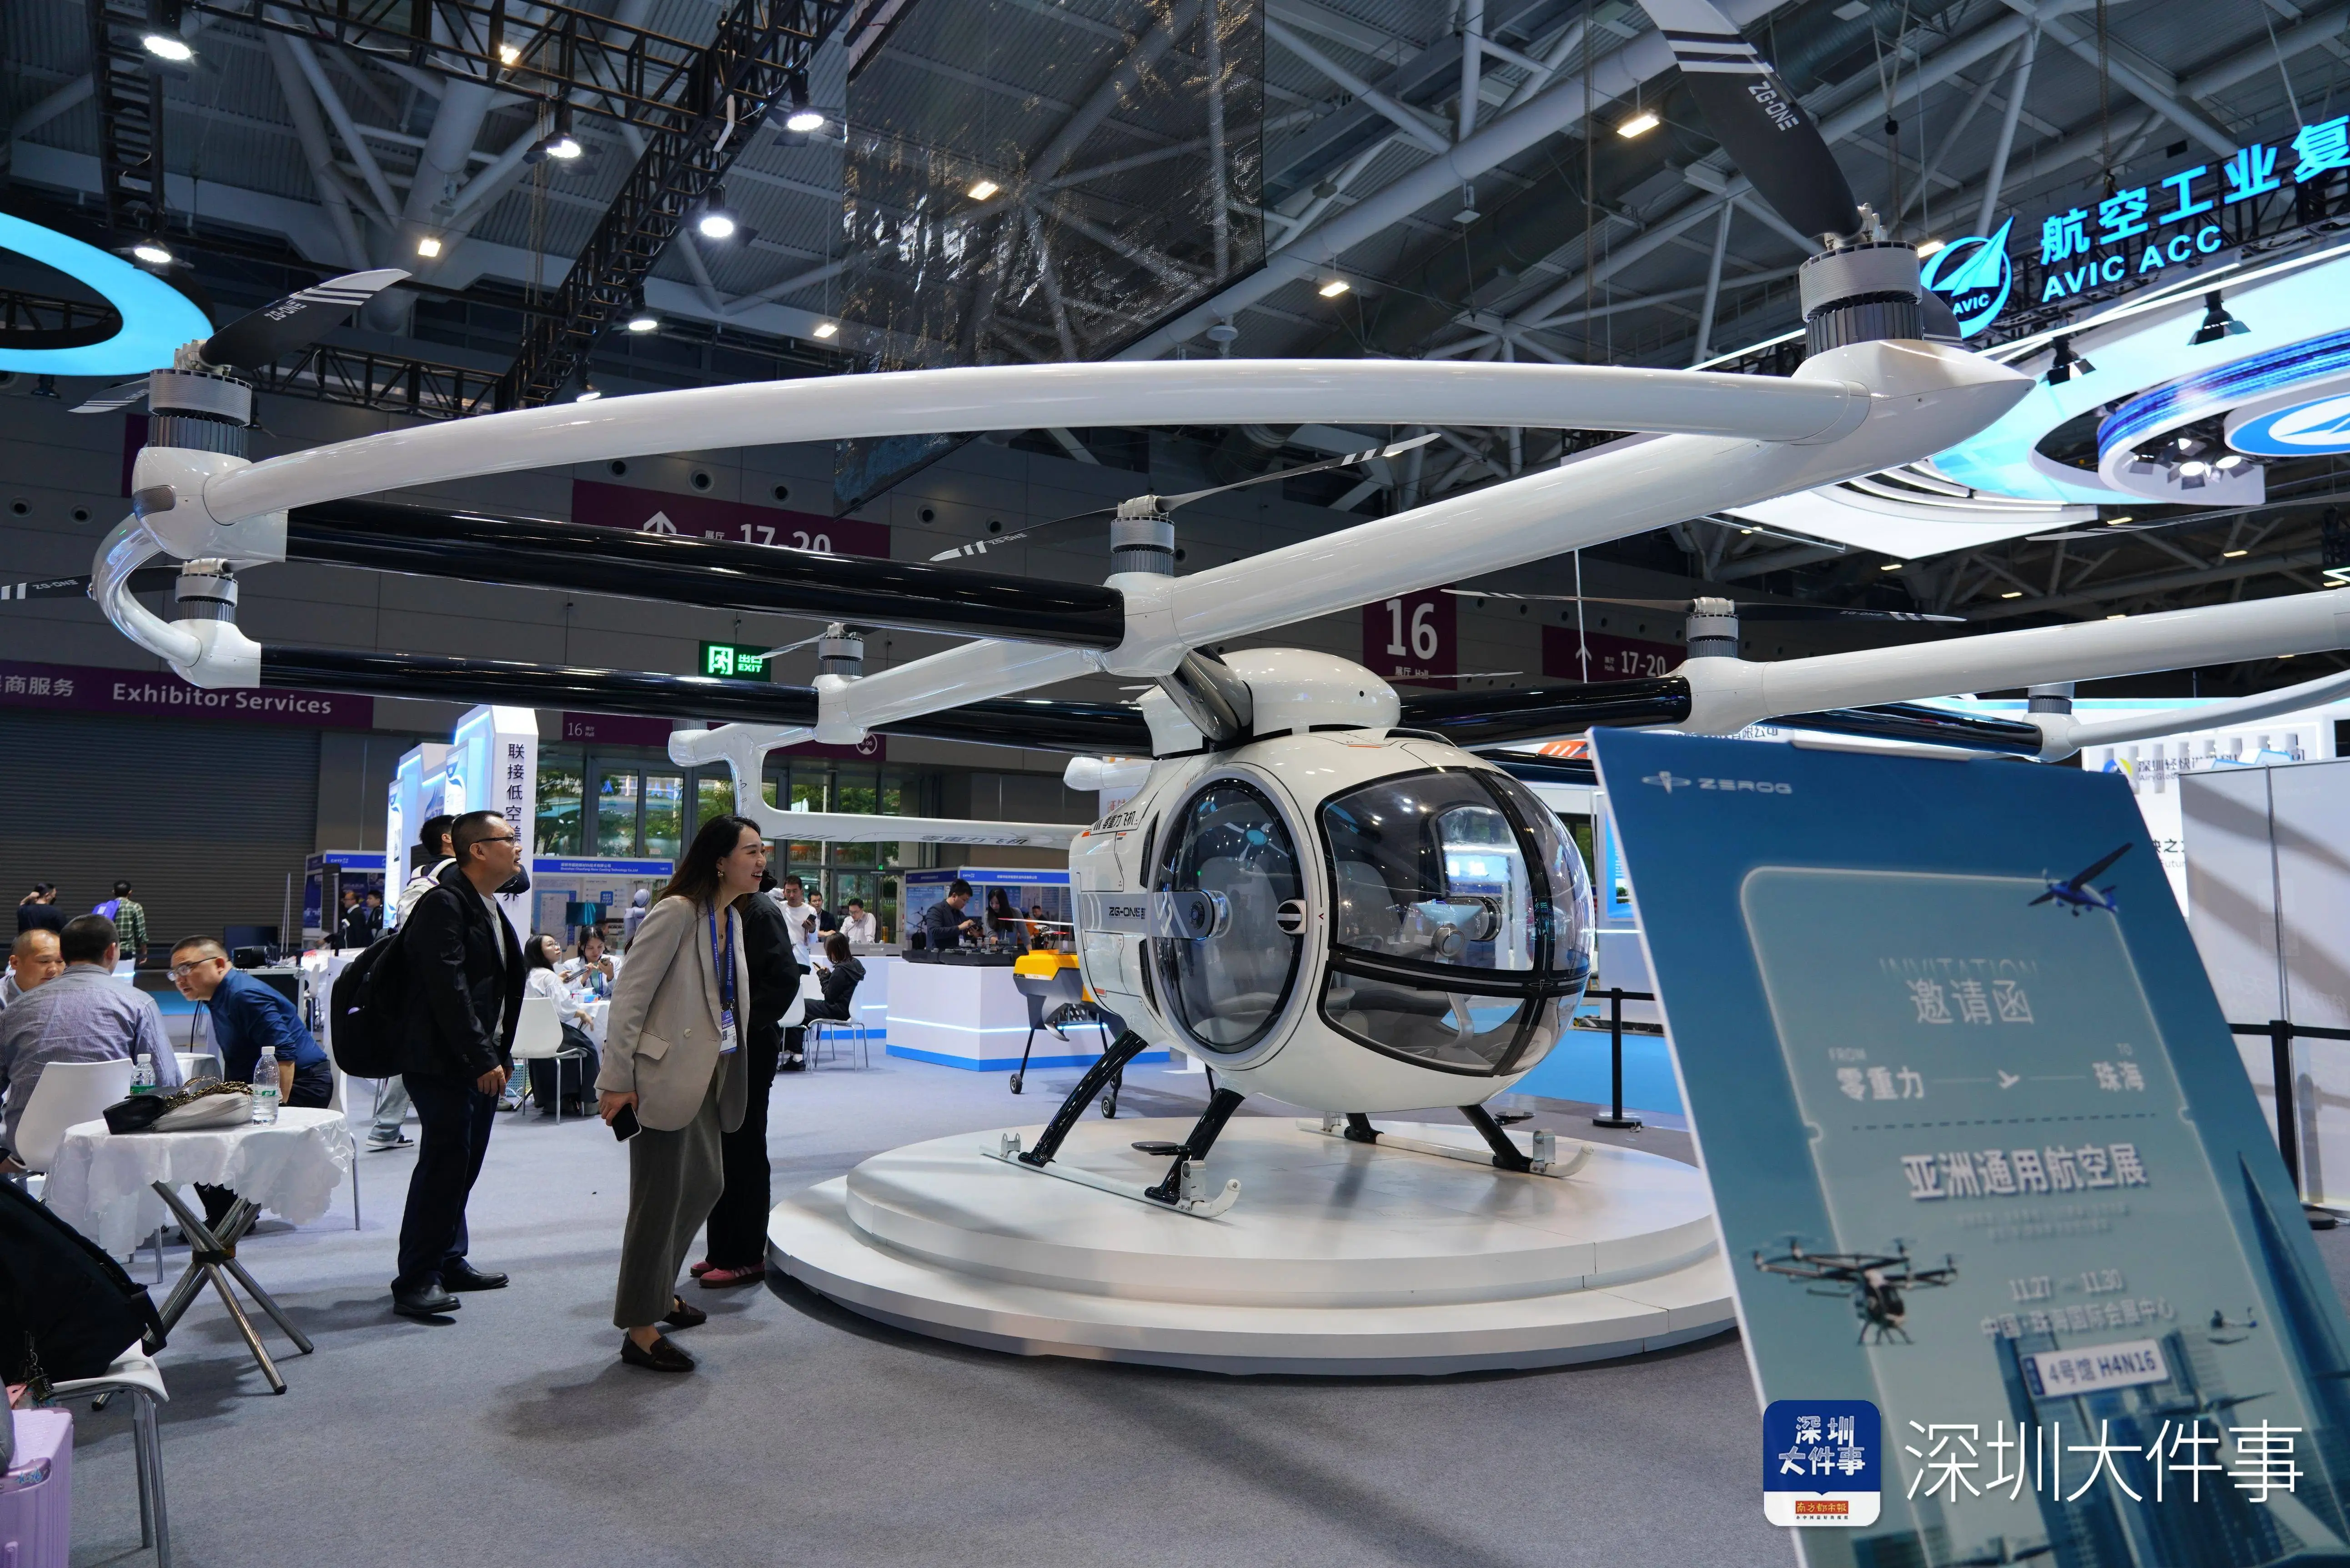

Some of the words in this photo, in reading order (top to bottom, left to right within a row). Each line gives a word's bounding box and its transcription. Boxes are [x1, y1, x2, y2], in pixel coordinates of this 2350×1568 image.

[2040, 115, 2350, 266] 航空工业复
[2042, 255, 2126, 302] AVIC
[2139, 225, 2223, 274] ACC
[1953, 294, 1990, 315] AVIC
[1386, 598, 1438, 660] 16
[738, 654, 763, 664] 出口
[738, 663, 763, 673] EXIT
[1621, 650, 1666, 677] 17-20
[1395, 666, 1411, 677] 展厅
[0, 675, 74, 697] 商服务
[112, 683, 230, 707] Exhibitor
[235, 691, 331, 714] Services
[568, 722, 582, 736] 16
[1697, 778, 1793, 794] ZEROG
[1102, 810, 1136, 829] 零重力飞机
[1109, 906, 1141, 917] ZG-ONE
[1905, 978, 2035, 1025] 邀请函
[1836, 1065, 1924, 1101] 零重力
[2092, 1060, 2146, 1092] 珠海
[1900, 1142, 2149, 1200] 亚洲通用航空展
[2048, 1358, 2096, 1385] 4号馆
[2096, 1349, 2157, 1378] H4N16
